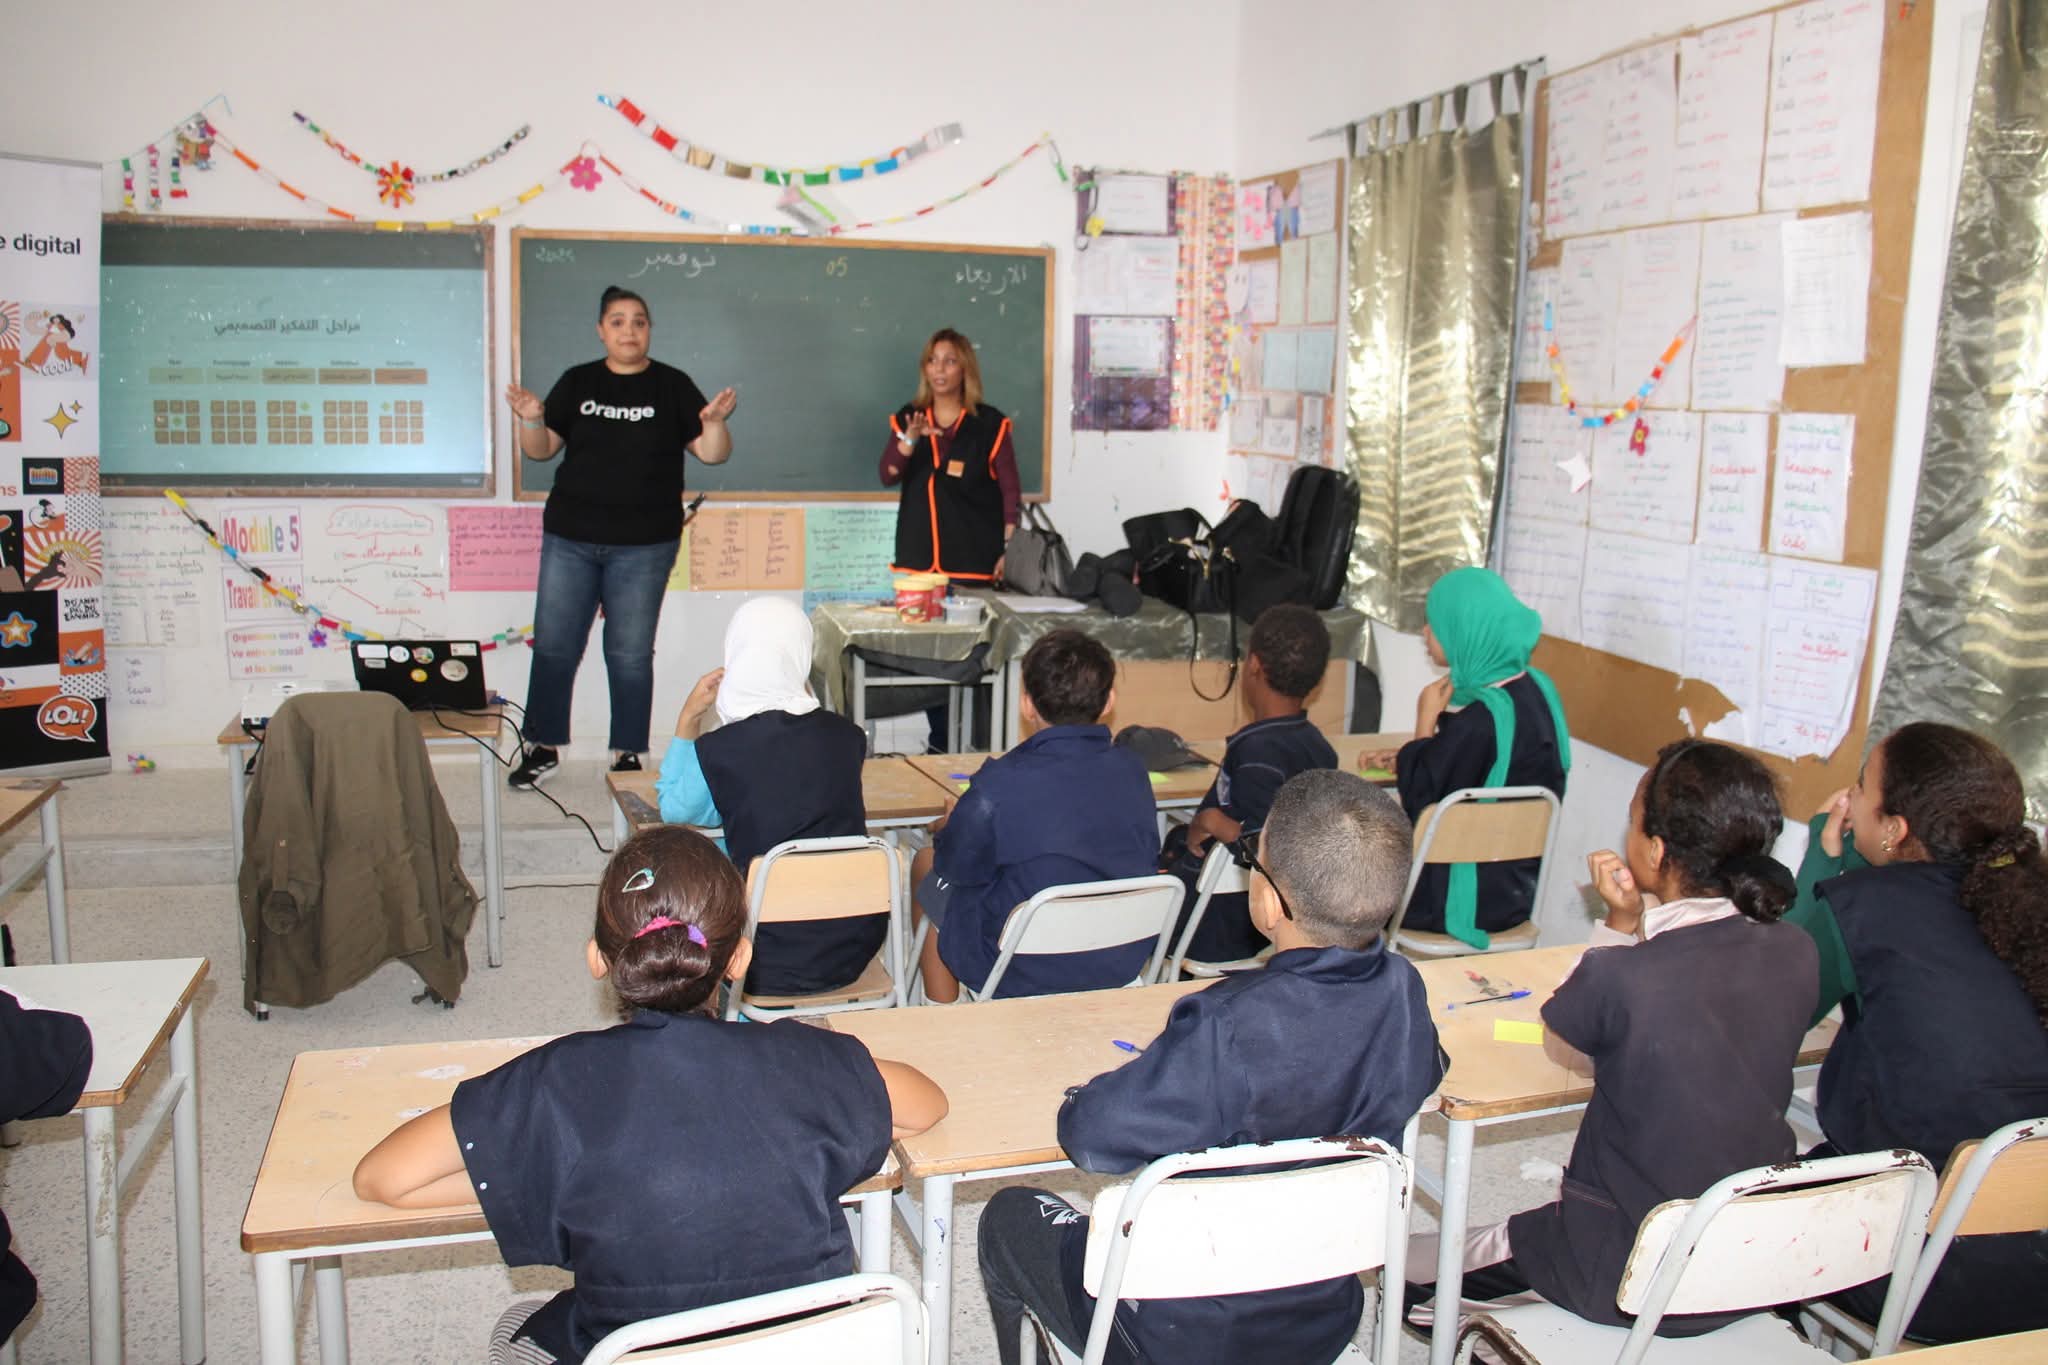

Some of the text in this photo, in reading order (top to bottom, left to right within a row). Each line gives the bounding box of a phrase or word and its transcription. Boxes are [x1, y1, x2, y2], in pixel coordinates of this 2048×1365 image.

[13, 232, 82, 257] digital
[628, 246, 717, 279] نوفمبر
[826, 256, 849, 277] 05
[280, 316, 319, 334] التفكير
[326, 319, 361, 336] مراحل
[579, 399, 655, 423] Orange
[223, 515, 285, 555] Module
[289, 514, 301, 554] 5
[44, 705, 89, 725] LOL!
